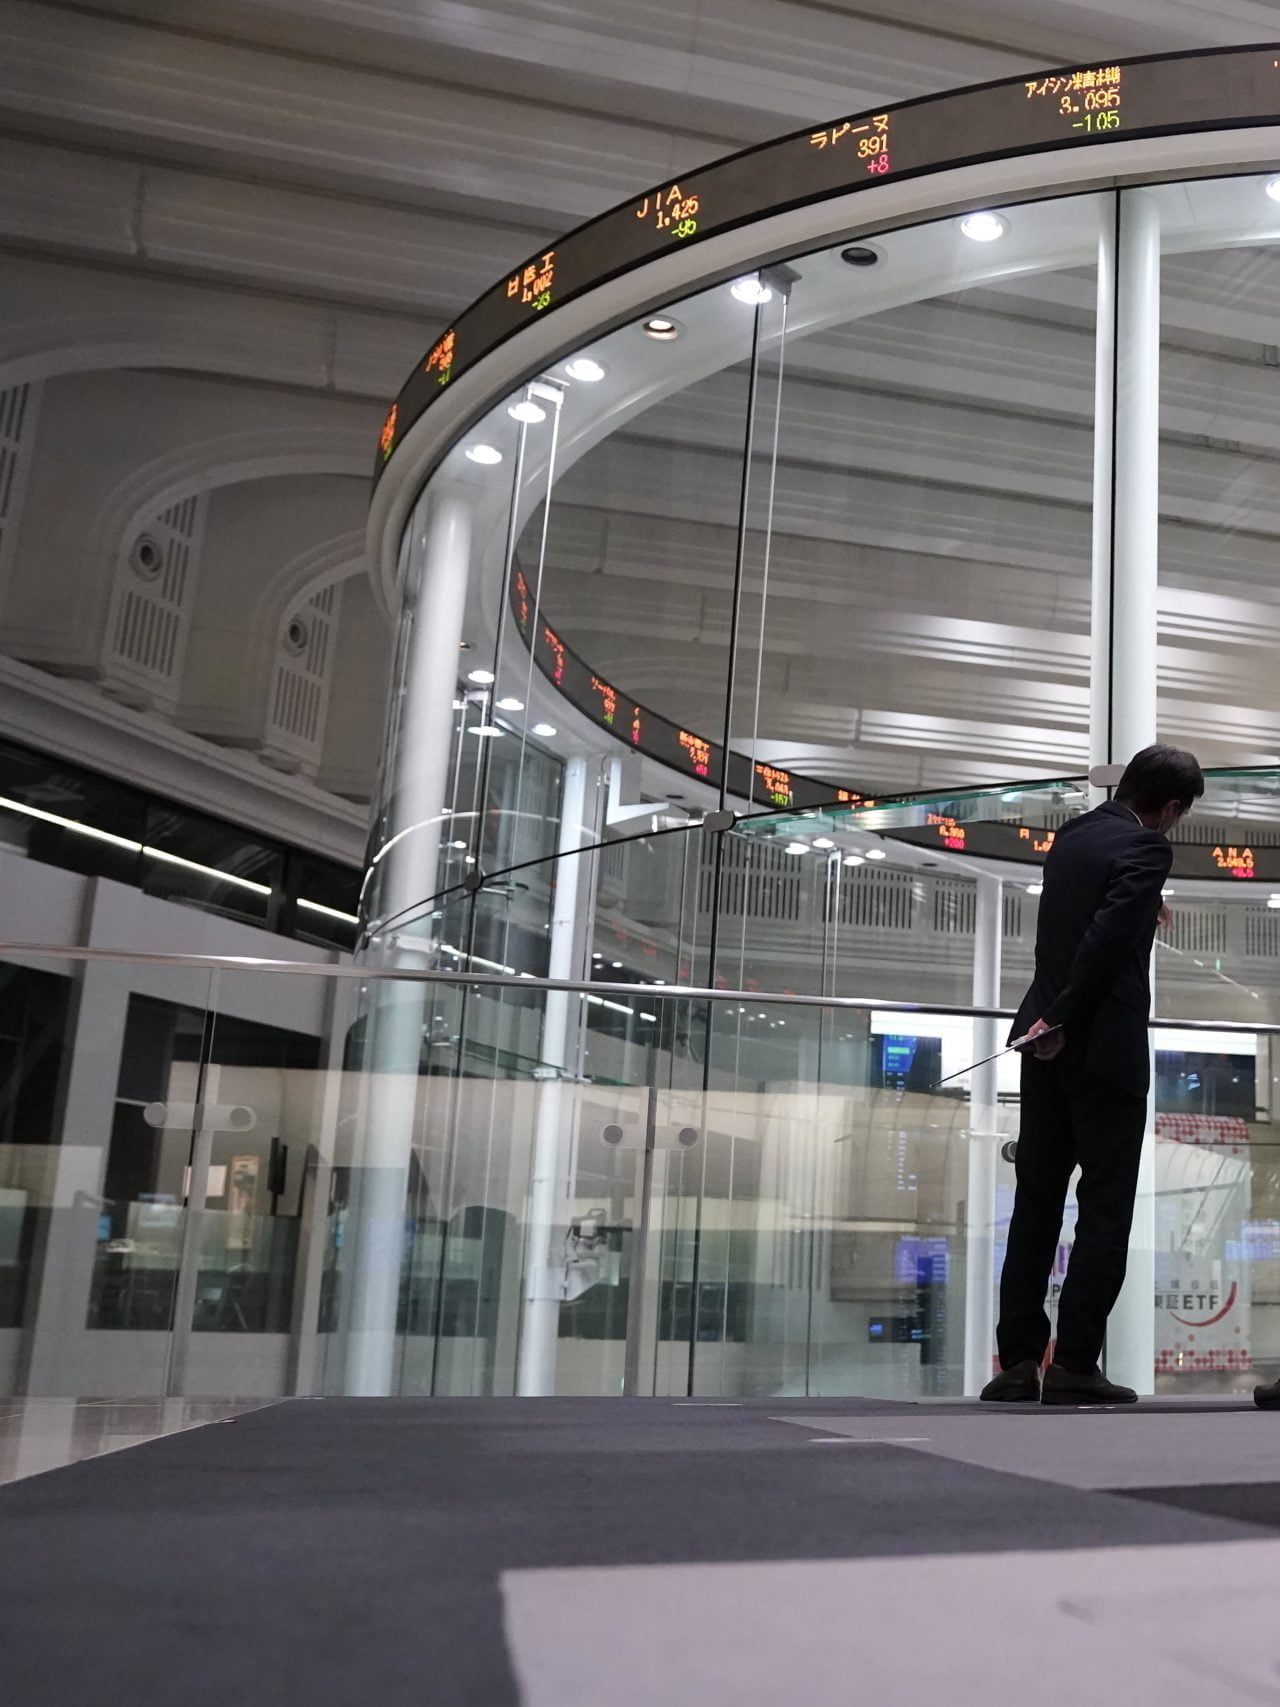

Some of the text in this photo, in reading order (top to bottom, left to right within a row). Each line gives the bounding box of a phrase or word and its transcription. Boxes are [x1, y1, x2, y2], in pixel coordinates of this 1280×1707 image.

[1072, 110, 1120, 132] -105
[857, 133, 889, 158] 391
[867, 154, 889, 173] +8
[636, 184, 683, 218] JIA
[1212, 846, 1253, 858] ANA
